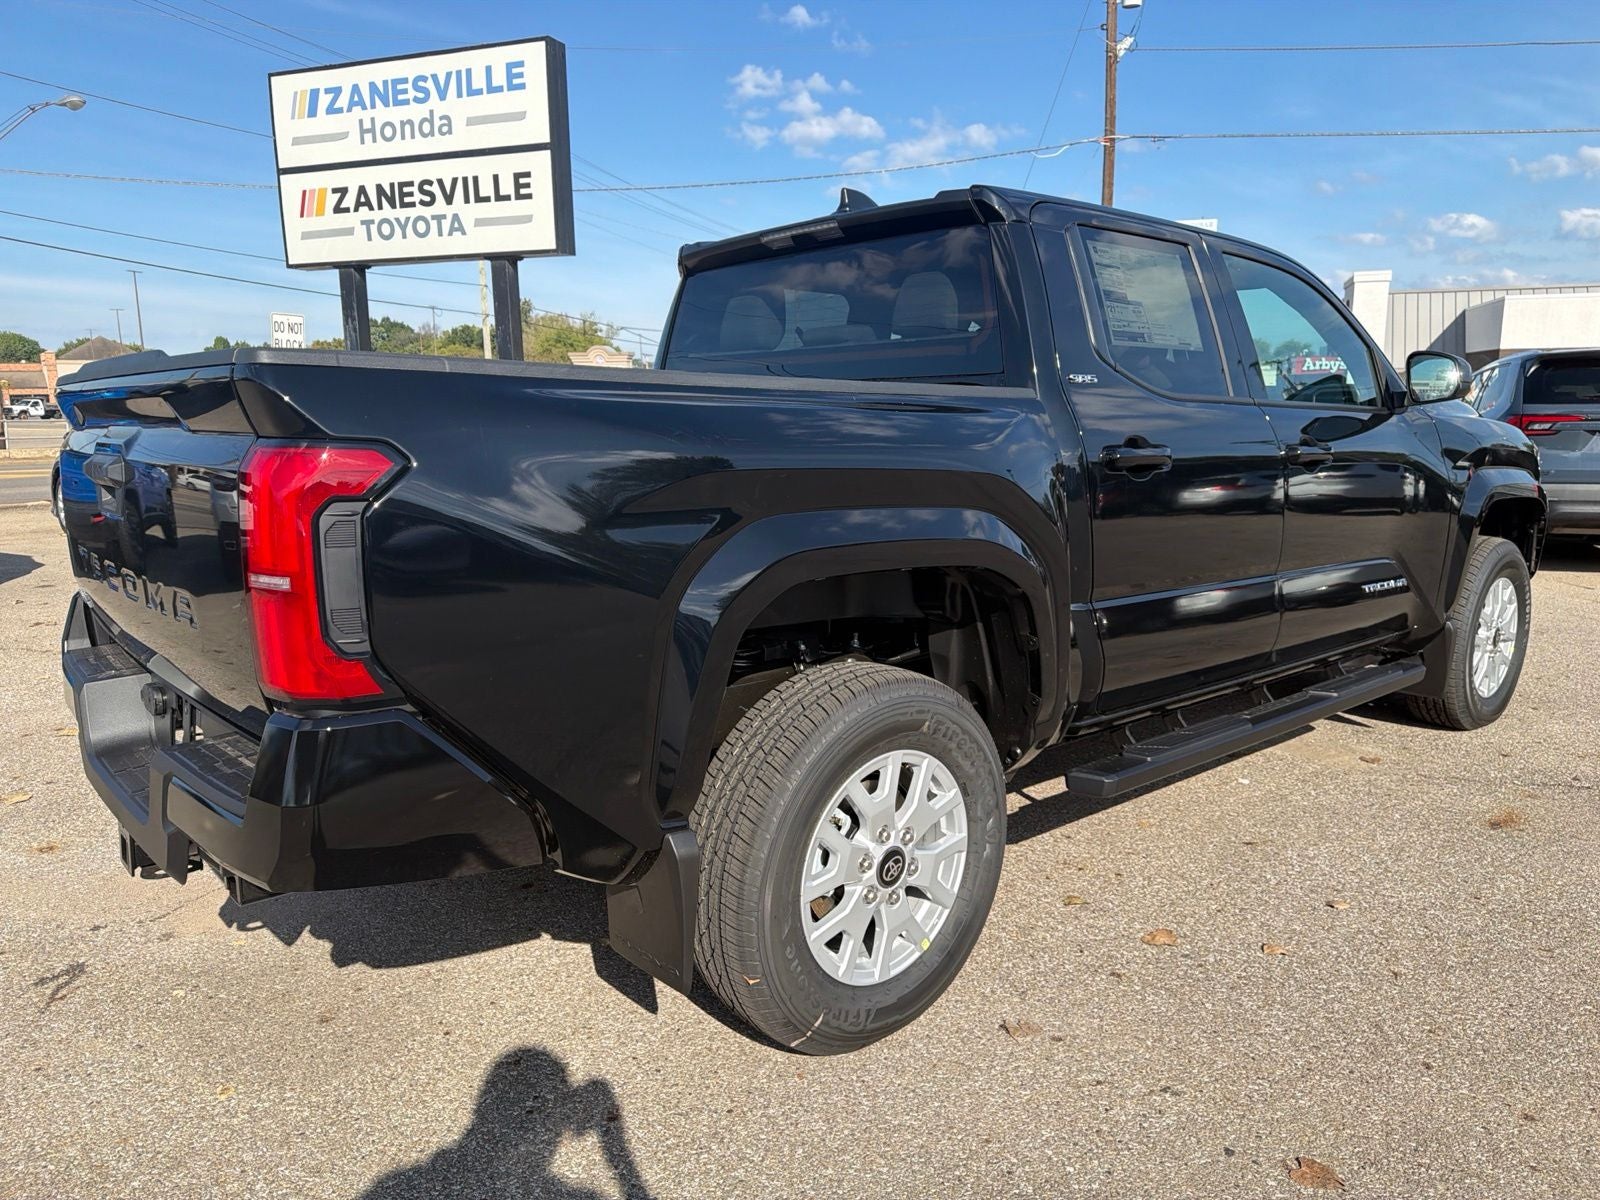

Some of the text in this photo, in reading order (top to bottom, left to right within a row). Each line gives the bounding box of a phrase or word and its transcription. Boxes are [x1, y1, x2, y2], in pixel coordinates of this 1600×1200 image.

[324, 60, 527, 116] ZANESVILLE
[358, 109, 453, 145] Honda
[331, 171, 533, 215] ZANESVILLE
[360, 213, 467, 242] TOYOTA
[273, 320, 303, 335] DO NOT
[274, 338, 304, 348] BLOCK
[1302, 356, 1347, 373] Arby's
[77, 544, 200, 630] TACOMA
[1360, 577, 1409, 594] TACOMA
